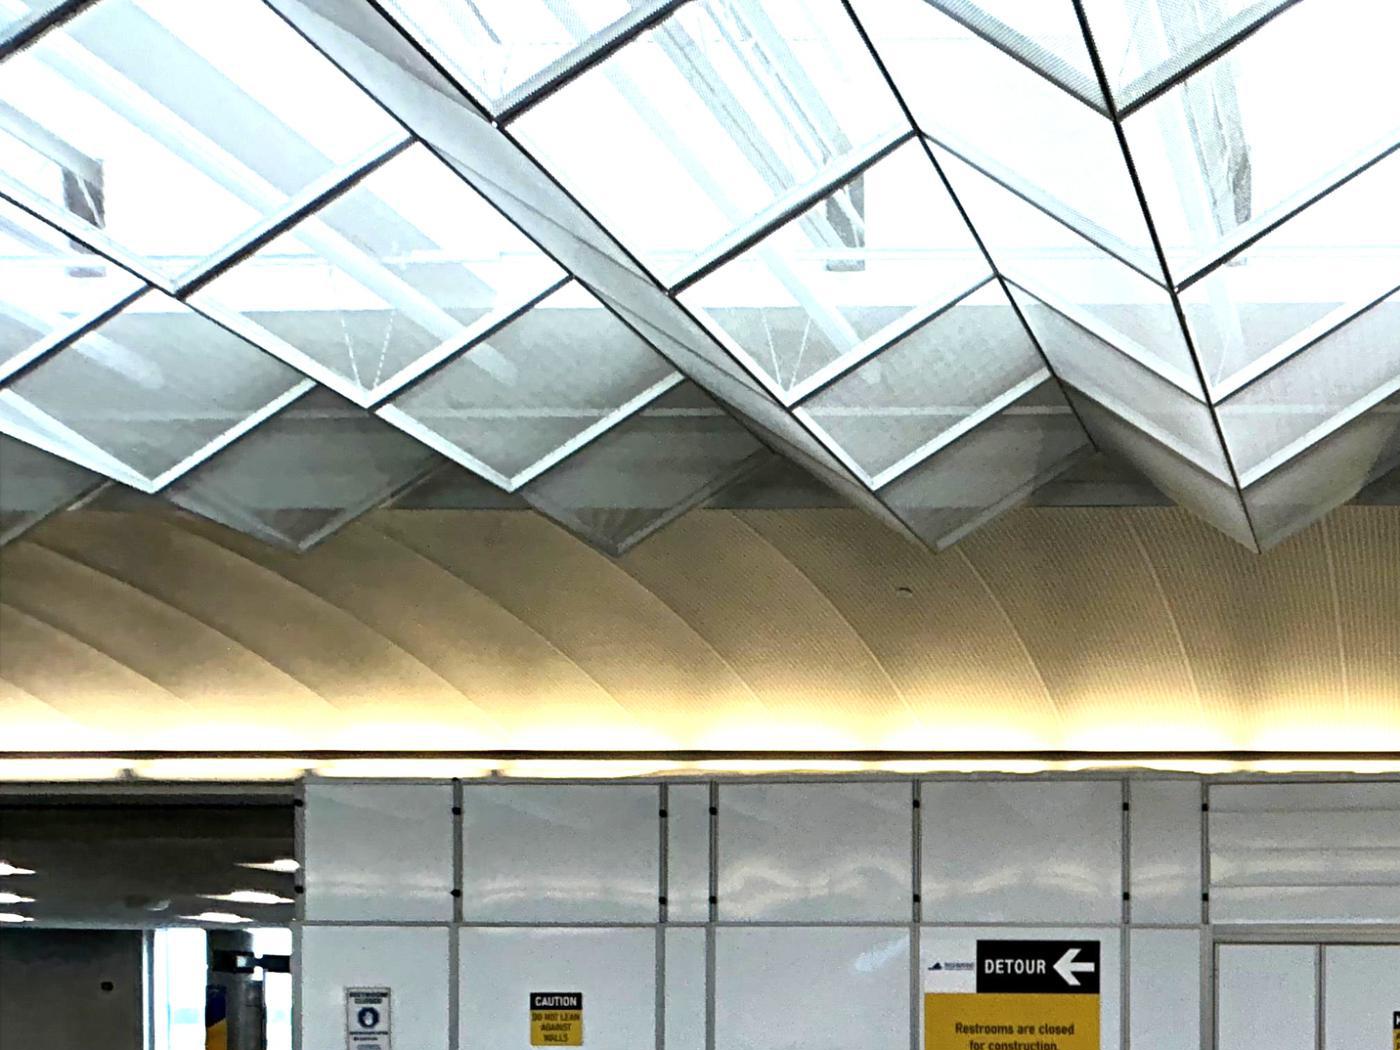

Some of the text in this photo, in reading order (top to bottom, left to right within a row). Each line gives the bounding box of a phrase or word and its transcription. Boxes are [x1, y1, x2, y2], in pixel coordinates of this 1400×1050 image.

[984, 959, 1046, 974] DETOUR
[535, 996, 577, 1007] CAUTION
[955, 1022, 1075, 1034] Restrooms are closed
